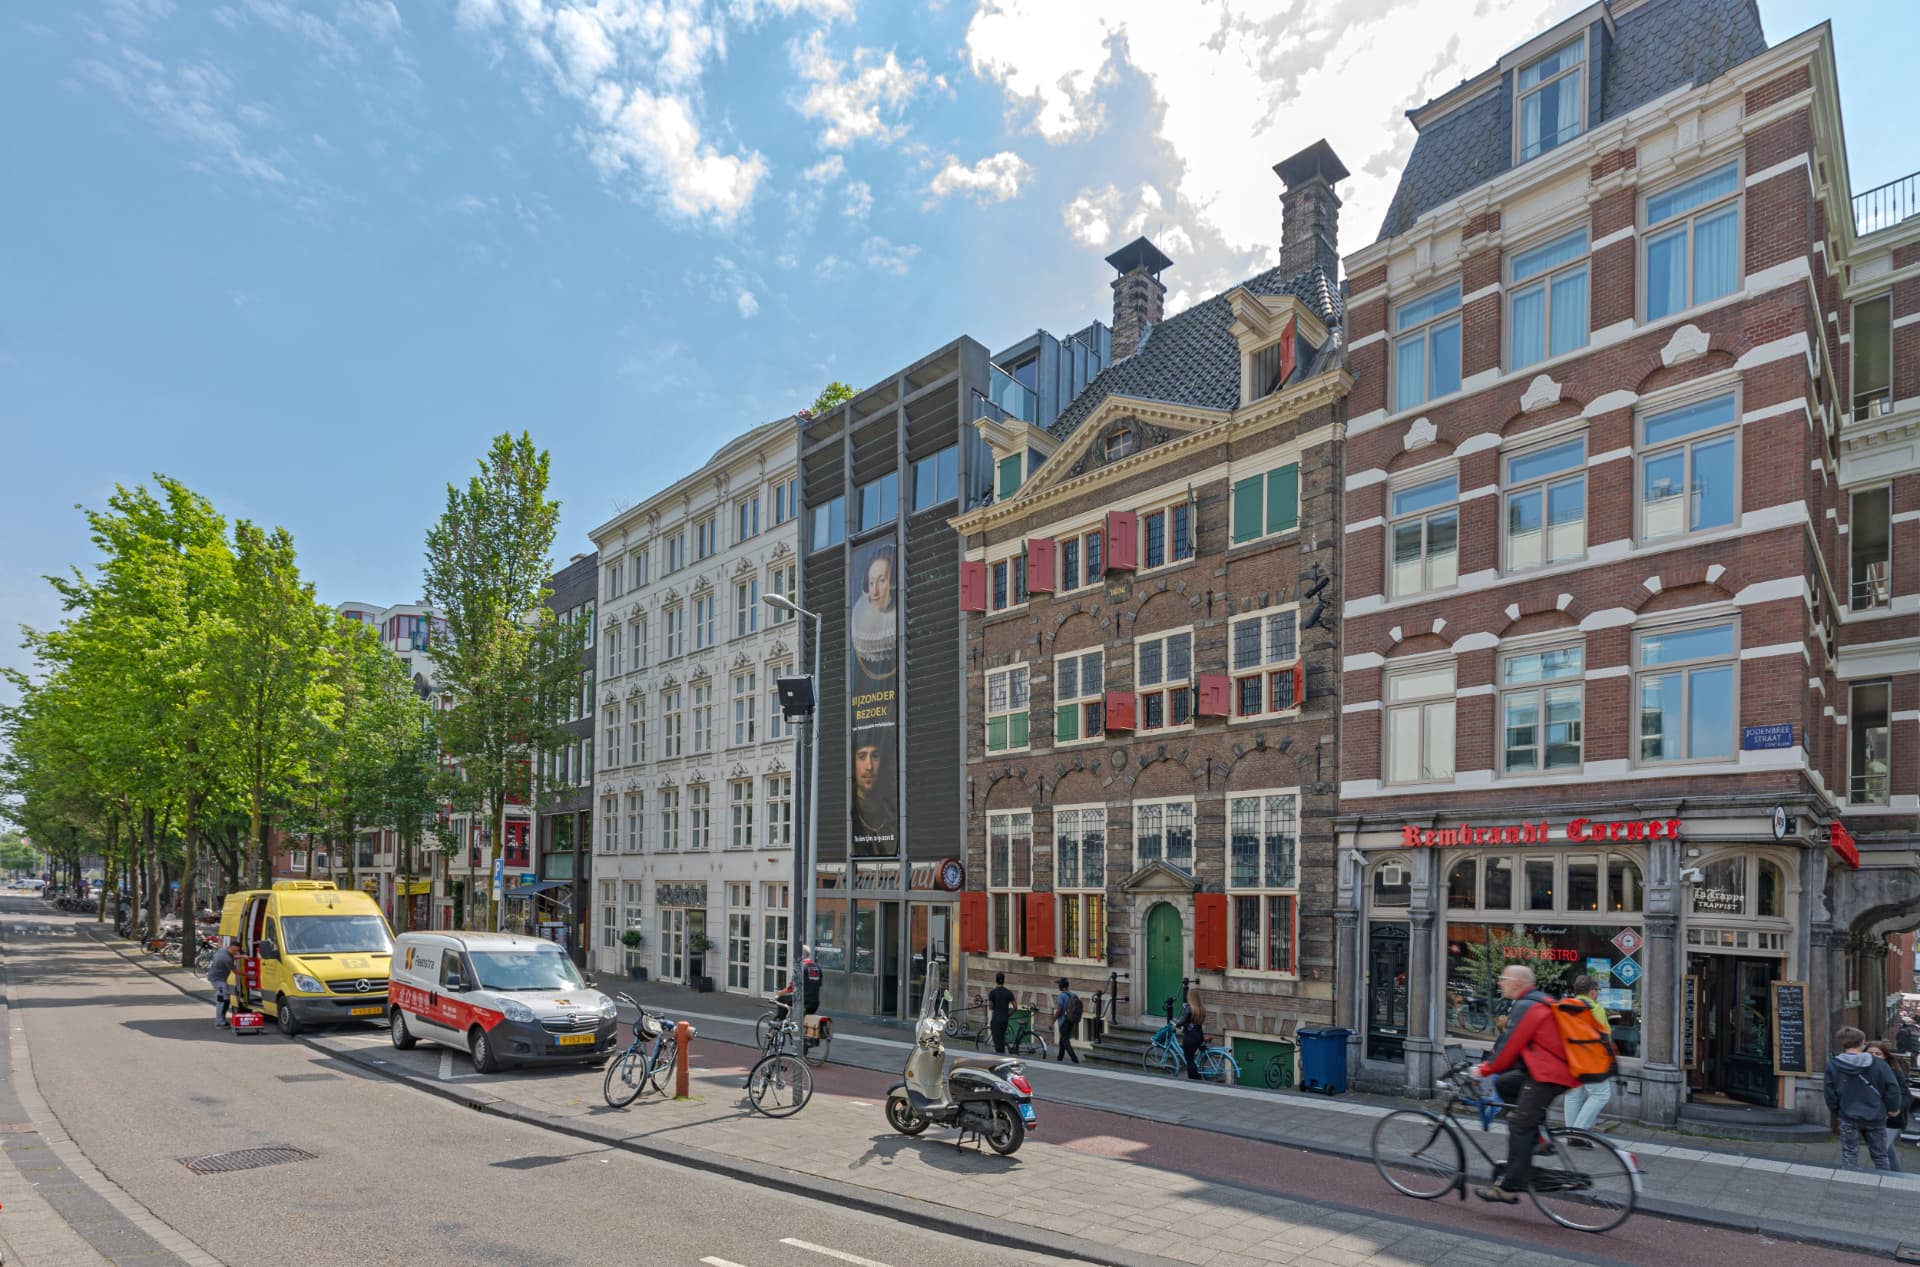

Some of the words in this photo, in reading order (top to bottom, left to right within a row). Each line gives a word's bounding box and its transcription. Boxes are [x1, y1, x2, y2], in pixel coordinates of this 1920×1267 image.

[852, 690, 895, 707] BIJZONDER
[856, 706, 888, 720] BEZOEK
[1754, 735, 1782, 744] STRAAT
[1401, 820, 1549, 847] Rembrandt
[1566, 817, 1681, 842] Corner
[495, 861, 501, 877] P
[1694, 887, 1706, 900] La
[1706, 887, 1745, 903] Trappe
[1698, 901, 1738, 910] TRAPPIST
[1503, 946, 1537, 959] DUTCH
[1540, 948, 1579, 961] BISTRO
